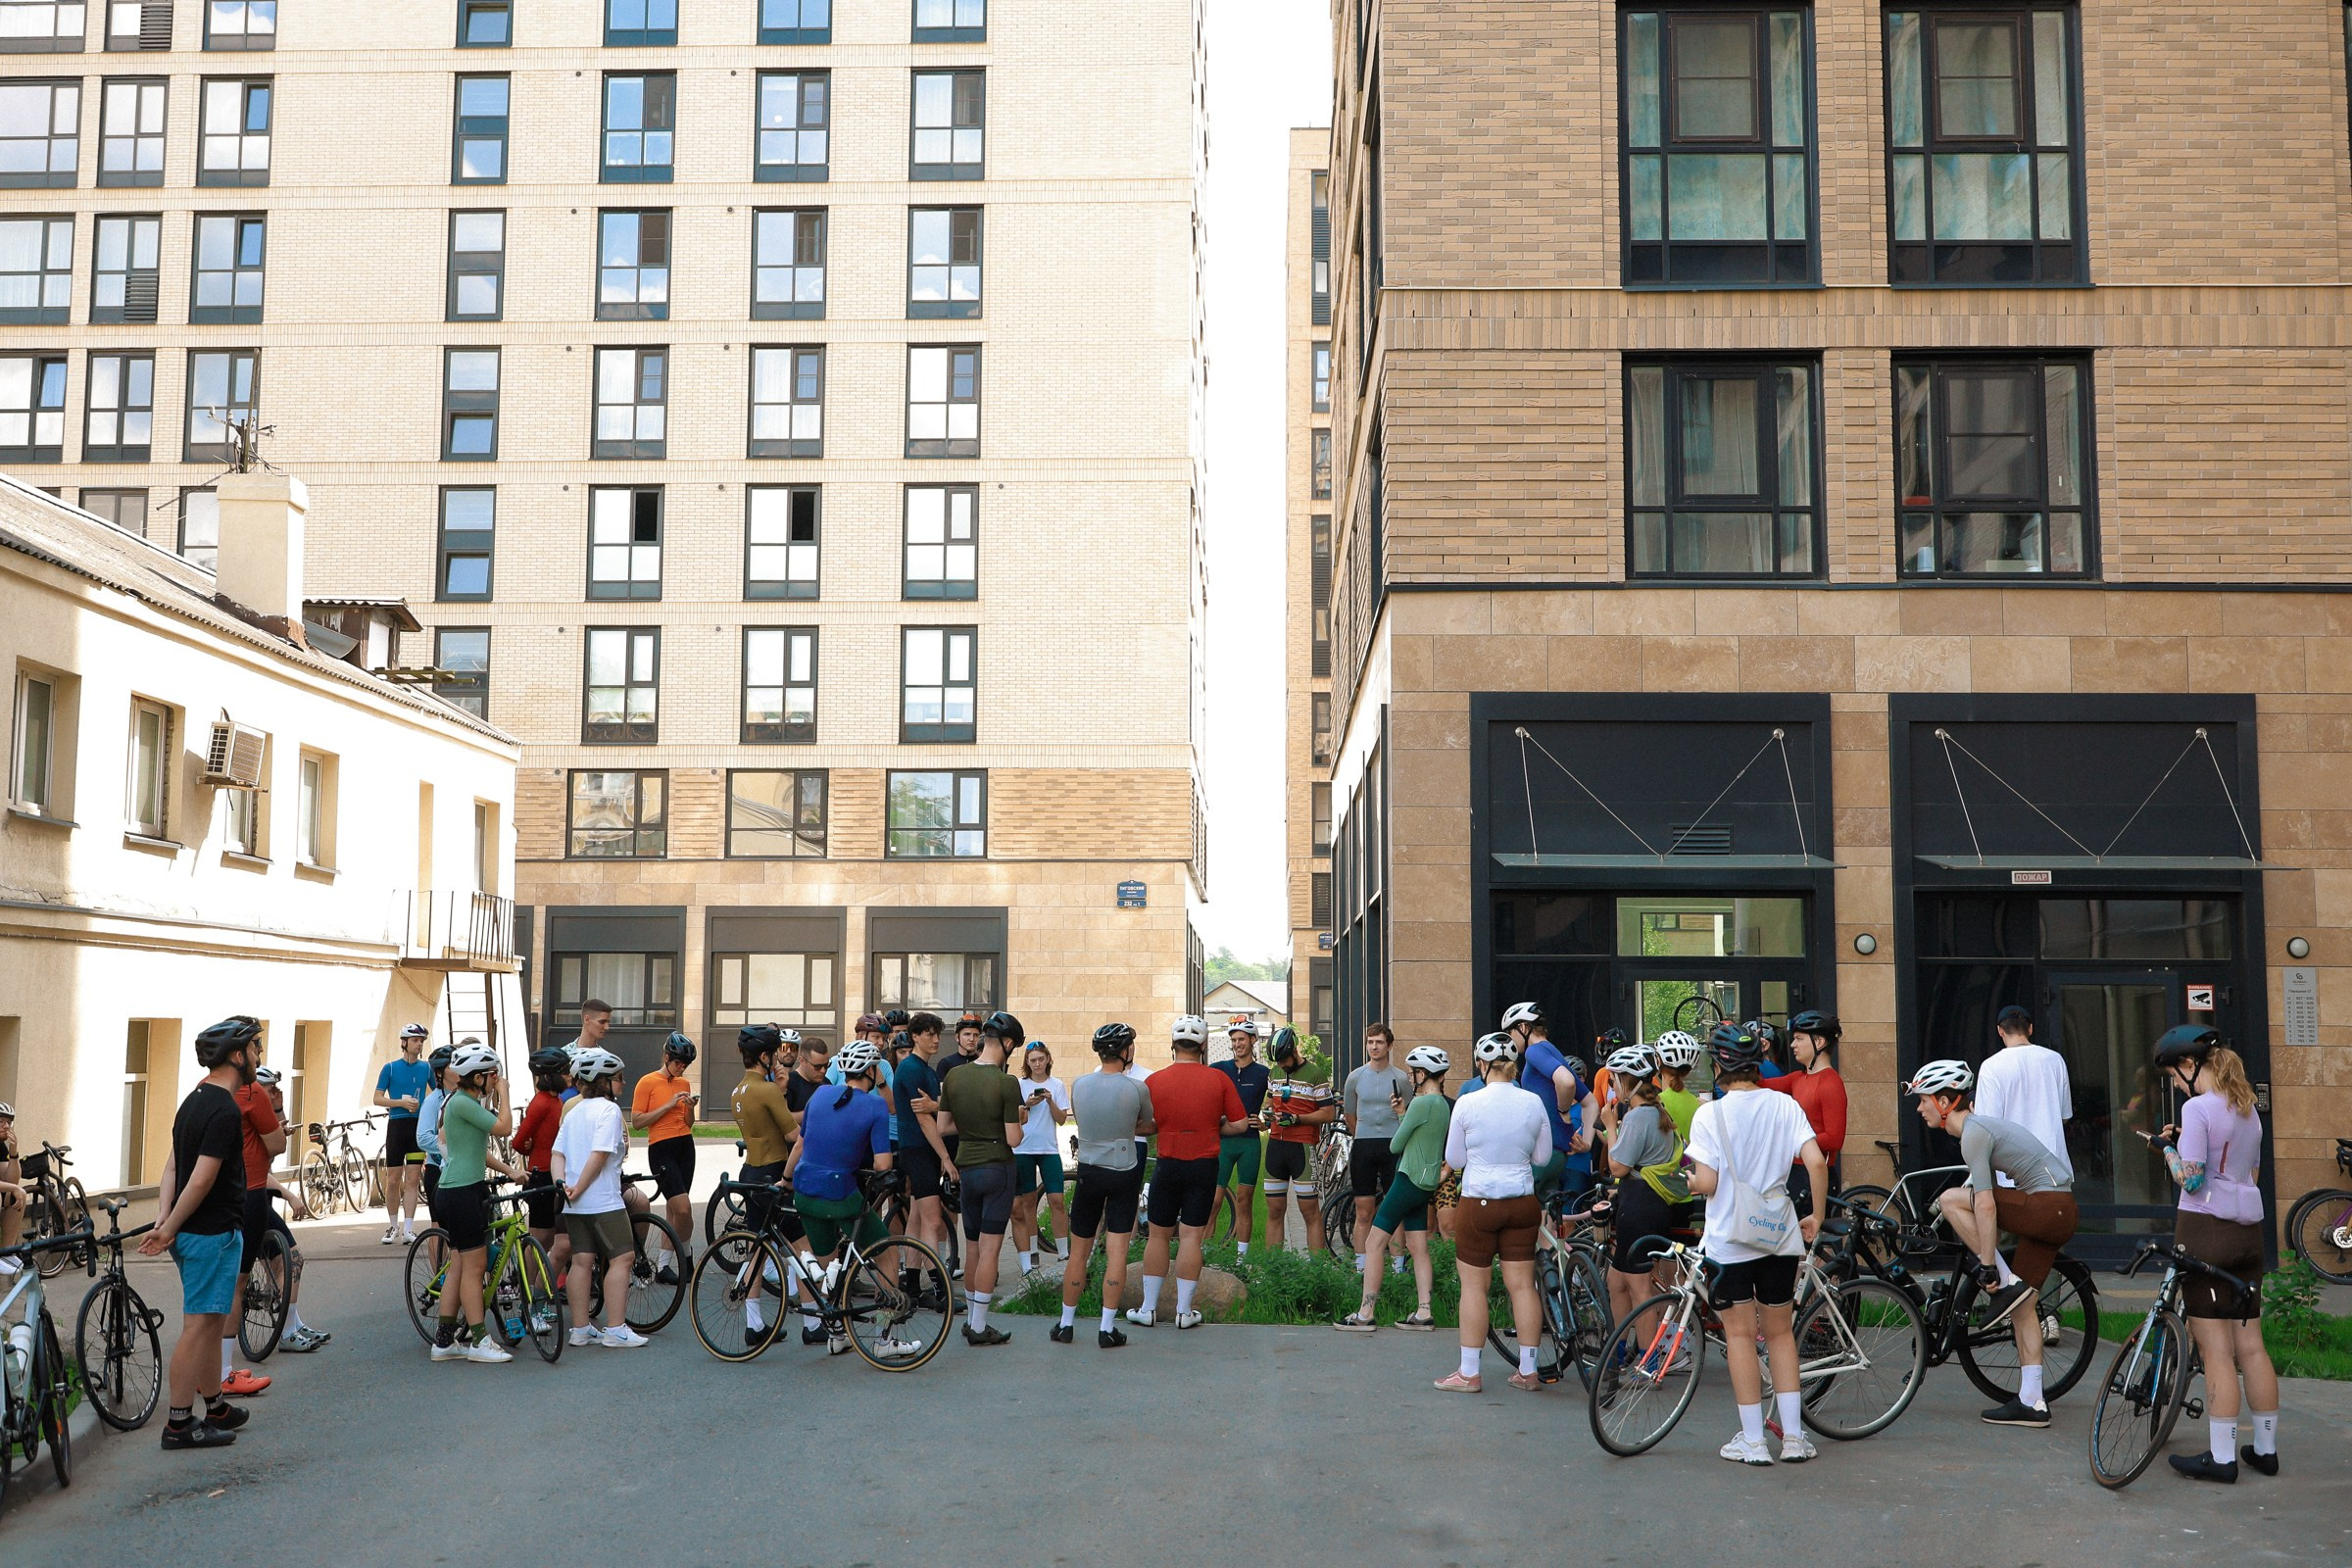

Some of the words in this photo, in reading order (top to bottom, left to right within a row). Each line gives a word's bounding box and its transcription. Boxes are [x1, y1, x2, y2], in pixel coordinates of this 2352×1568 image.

[2015, 873, 2048, 882] ПОЖАР
[736, 1102, 741, 1112] S
[1748, 1215, 1777, 1232] Cycling
